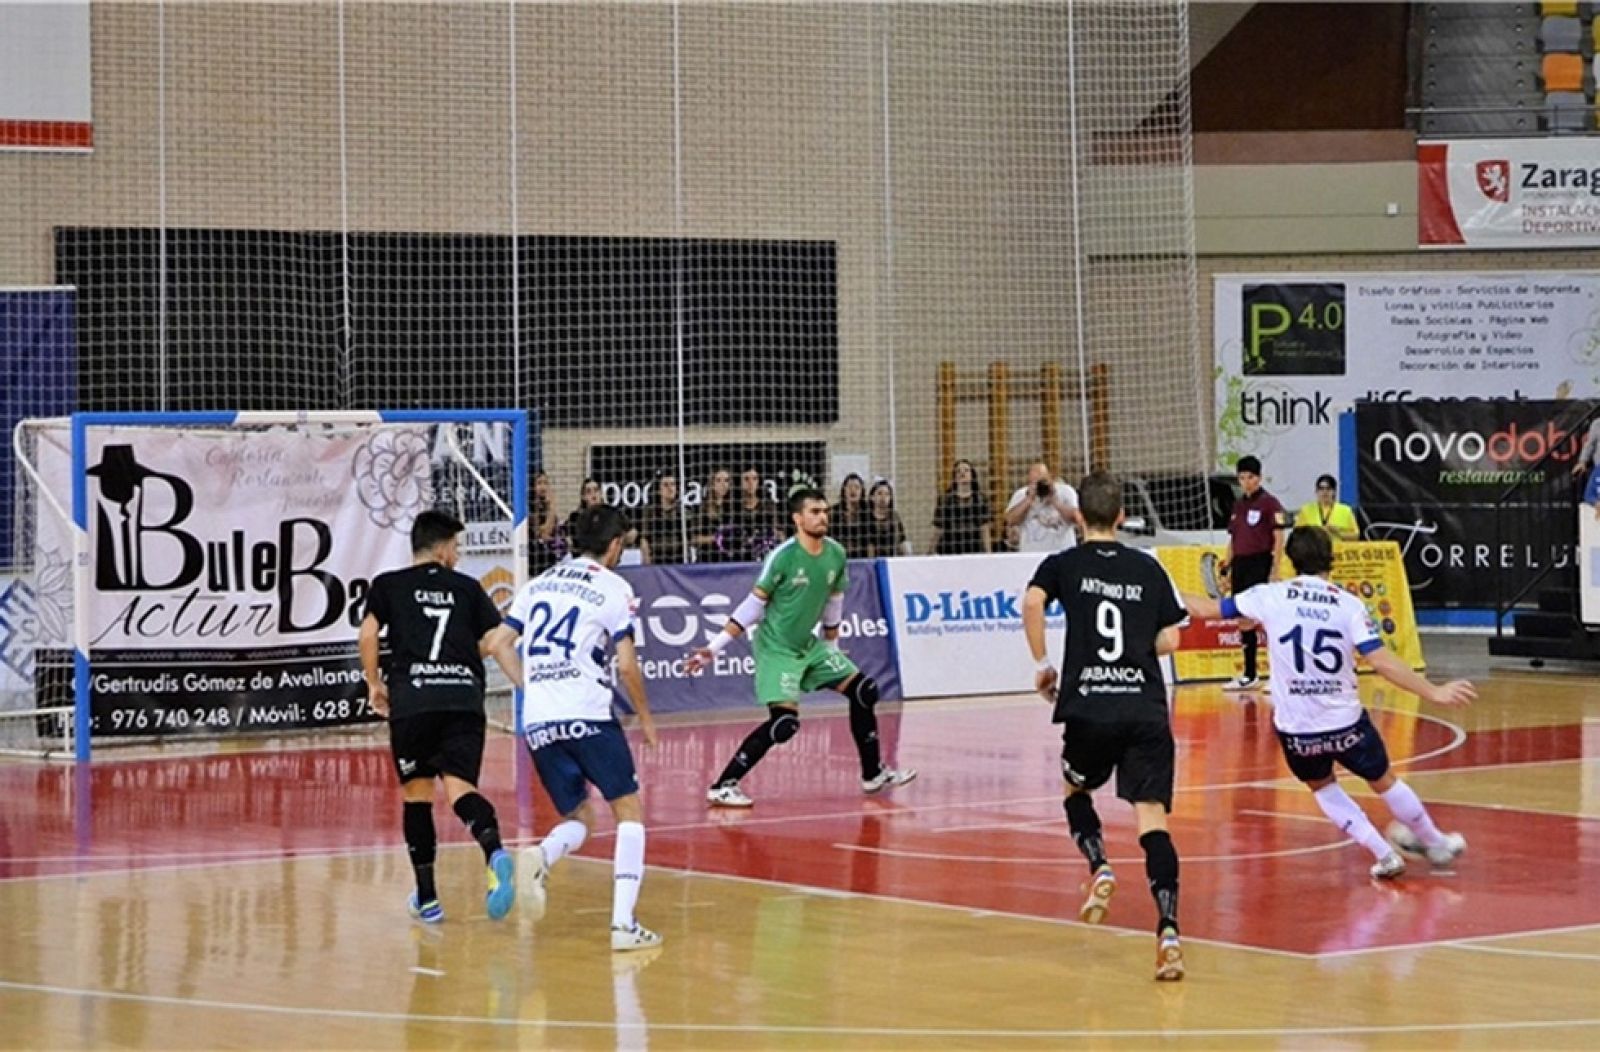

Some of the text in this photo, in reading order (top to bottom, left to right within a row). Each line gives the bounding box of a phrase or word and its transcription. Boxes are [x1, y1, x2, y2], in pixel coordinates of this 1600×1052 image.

[1298, 302, 1343, 330] 4.0
[1241, 391, 1331, 425] think
[903, 589, 1022, 622] D-Link
[1286, 588, 1340, 606] D-Link
[1295, 605, 1331, 621] NANO
[422, 607, 451, 661] 7
[528, 600, 581, 660] 24
[1096, 600, 1124, 662] 9
[1279, 624, 1343, 675] 15
[182, 671, 246, 692] Gómez
[250, 670, 272, 689] de
[111, 709, 148, 729] 976
[154, 708, 190, 728] 740
[193, 708, 230, 727] 248
[249, 703, 305, 724] Móvil:
[312, 701, 350, 719] 628
